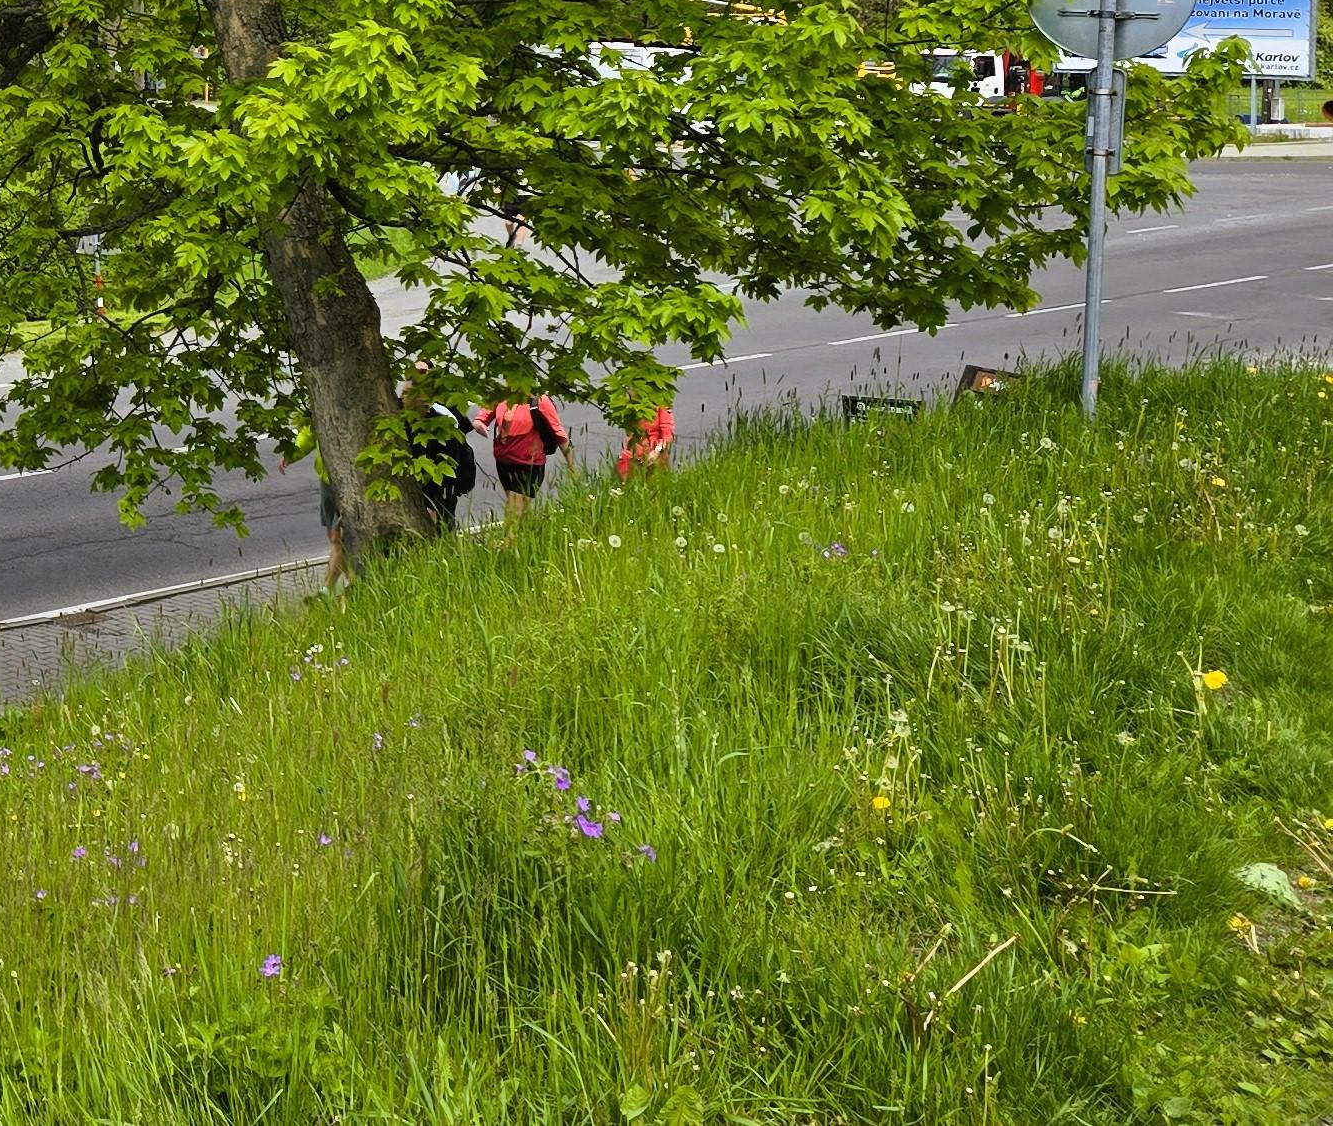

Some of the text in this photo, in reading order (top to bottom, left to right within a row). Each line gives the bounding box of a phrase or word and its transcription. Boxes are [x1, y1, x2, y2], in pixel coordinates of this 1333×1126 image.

[1233, 10, 1249, 18] na
[1253, 9, 1301, 19] Moravě
[1256, 52, 1300, 63] Karlov
